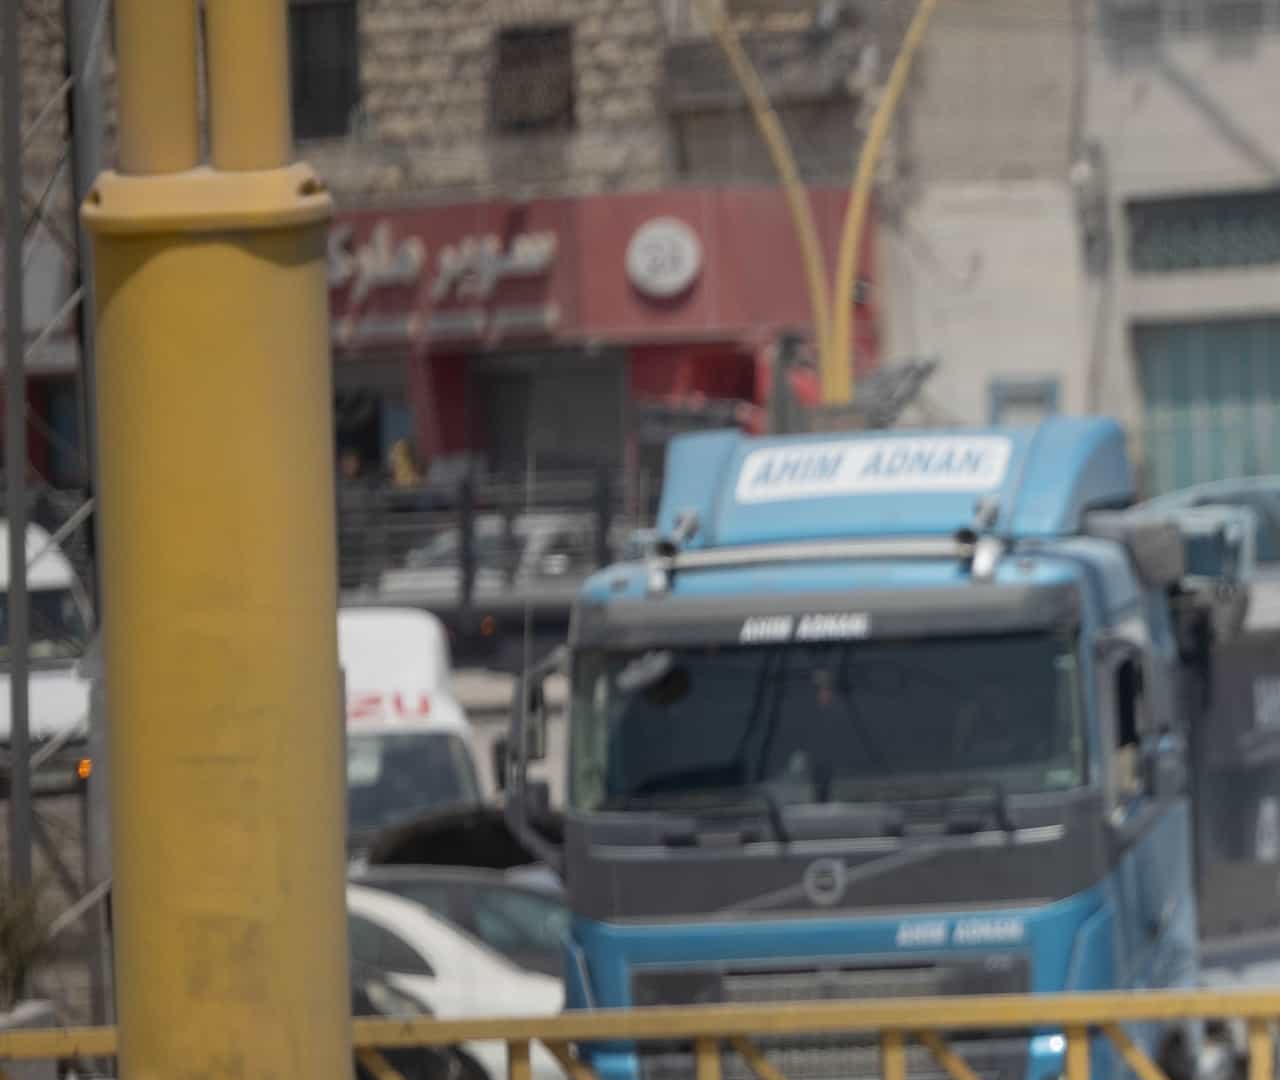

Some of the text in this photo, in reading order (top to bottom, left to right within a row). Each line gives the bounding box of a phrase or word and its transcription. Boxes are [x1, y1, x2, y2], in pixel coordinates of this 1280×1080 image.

[328, 220, 425, 304] مارك
[752, 447, 984, 486] AHIM ADNAN
[346, 689, 432, 721] ZU
